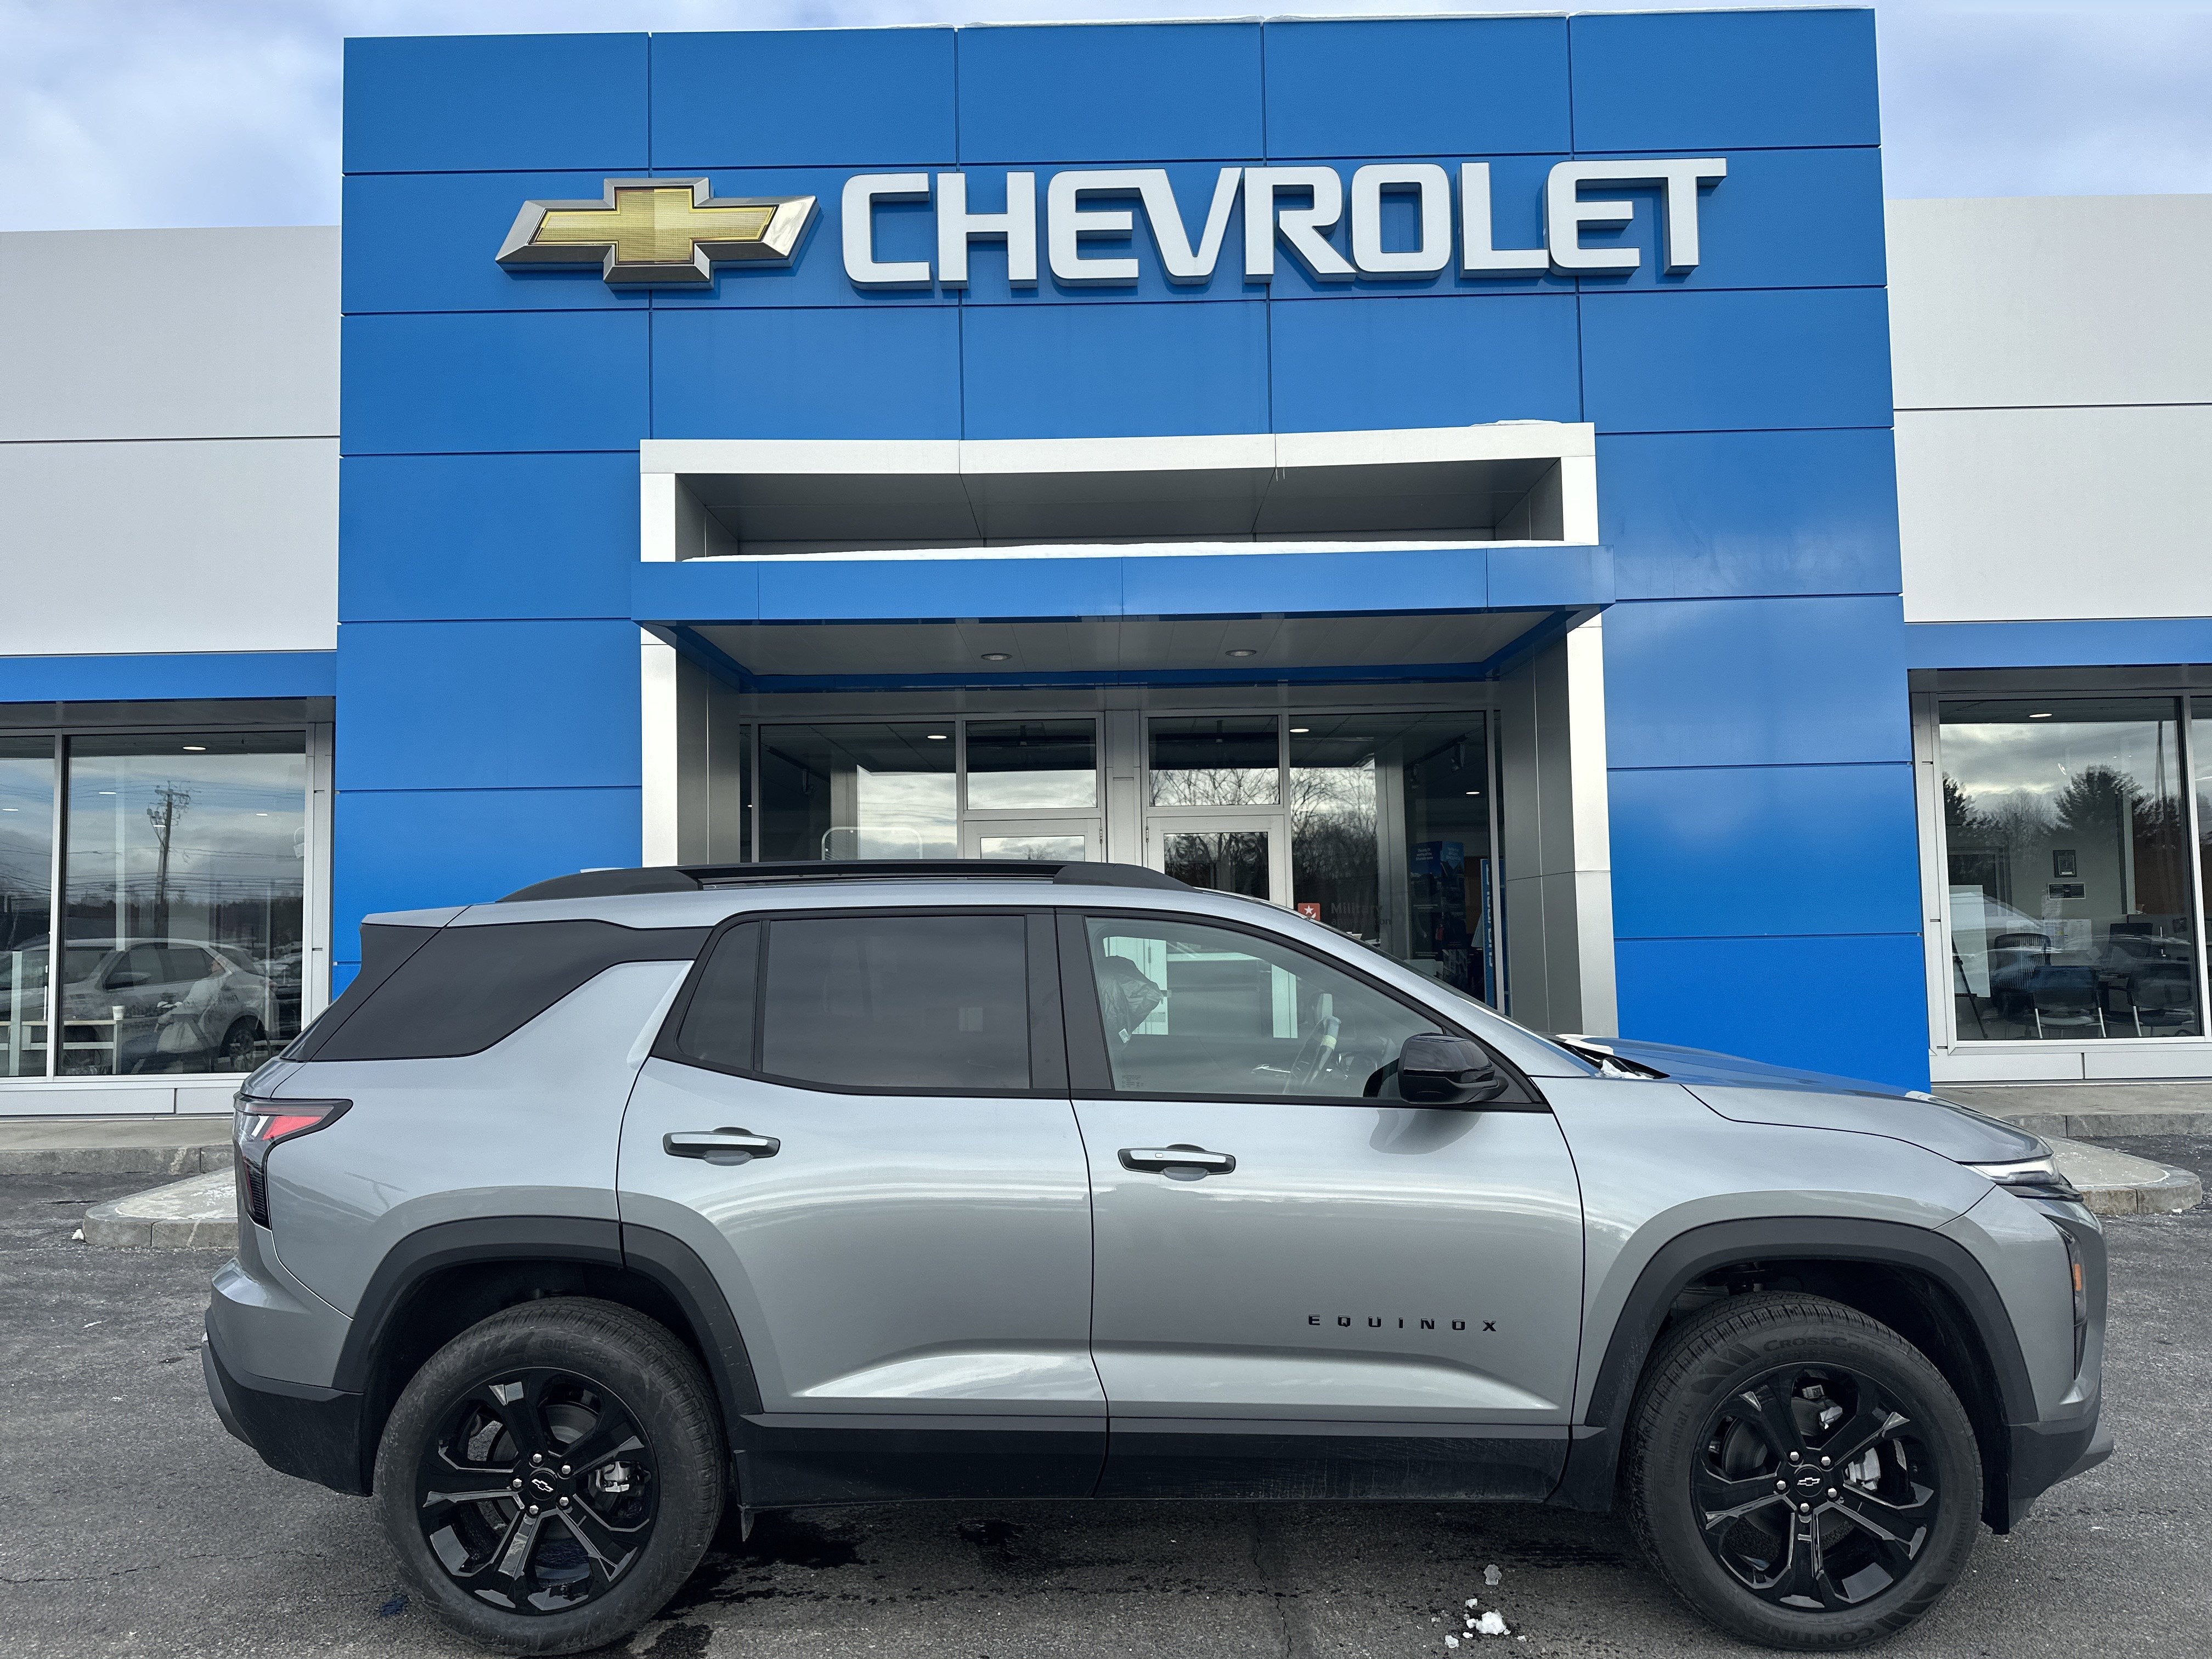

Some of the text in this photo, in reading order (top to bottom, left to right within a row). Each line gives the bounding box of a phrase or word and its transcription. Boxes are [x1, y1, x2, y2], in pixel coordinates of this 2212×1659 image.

[841, 157, 1727, 289] CHEVROLET
[1331, 902, 1383, 915] Military
[1308, 1314, 1497, 1331] EQUINOX
